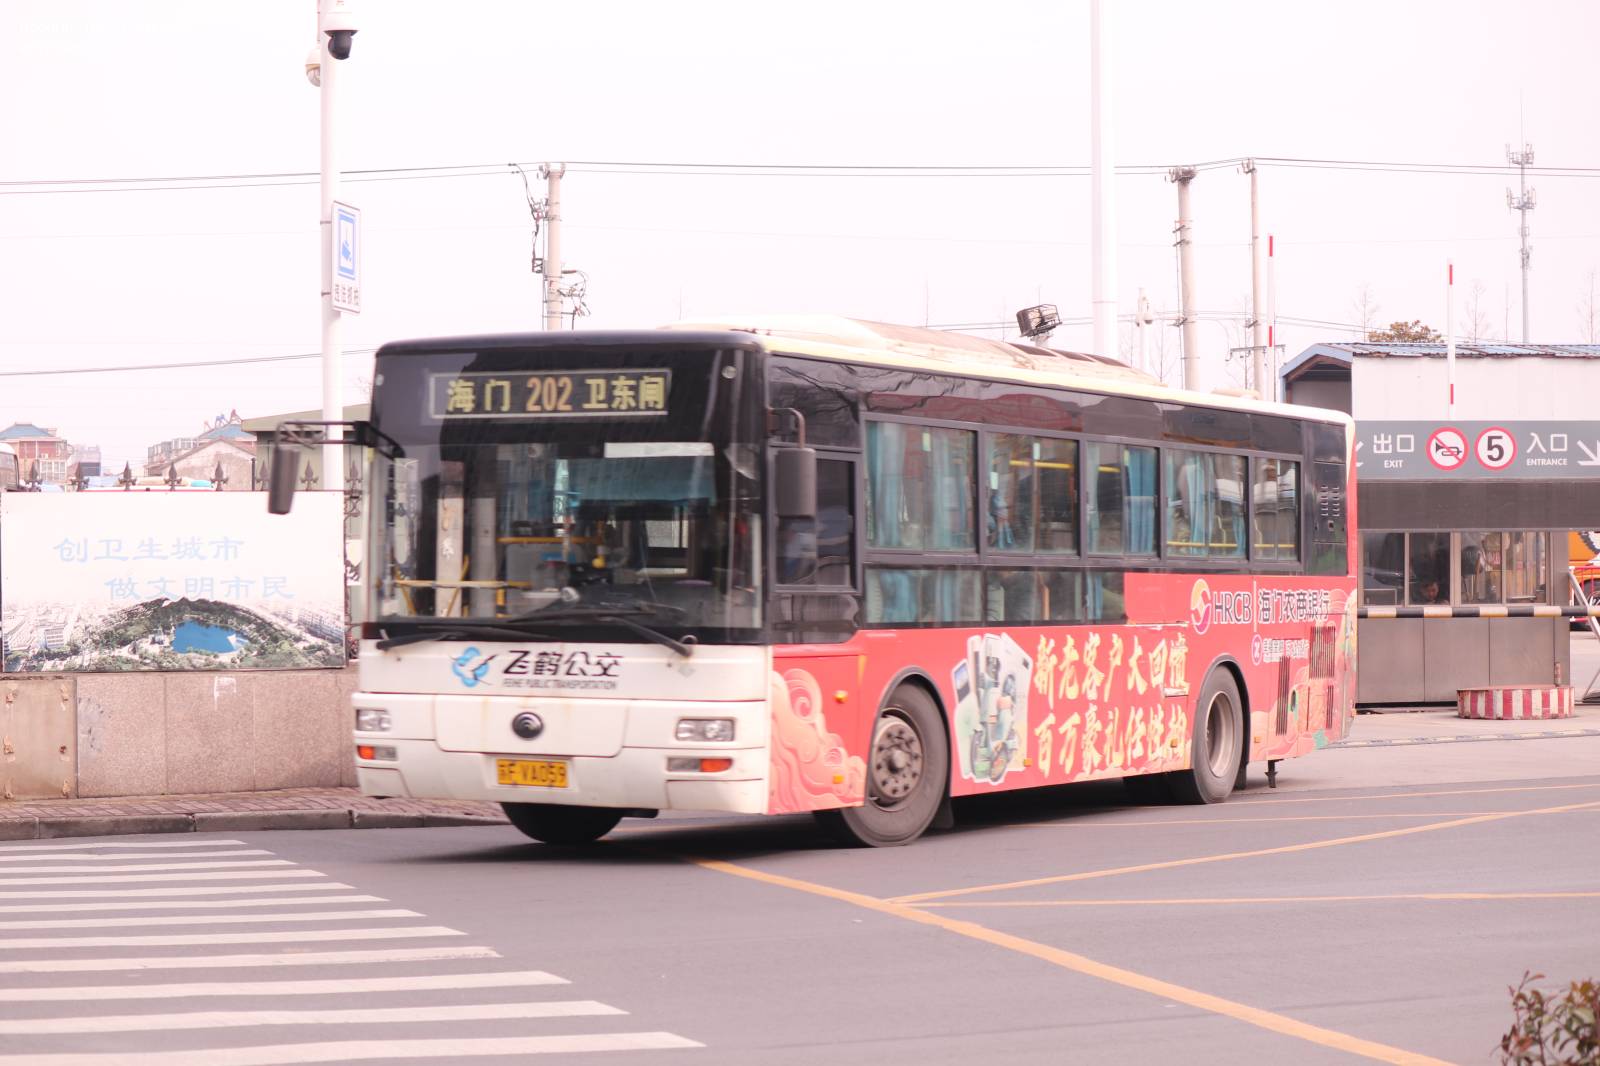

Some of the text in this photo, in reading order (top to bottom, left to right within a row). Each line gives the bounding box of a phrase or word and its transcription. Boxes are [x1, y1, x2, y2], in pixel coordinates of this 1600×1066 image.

[447, 379, 511, 412] 海门
[525, 376, 573, 412] 202
[1373, 433, 1414, 454] 出口
[1487, 436, 1504, 462] 5
[1526, 432, 1568, 453] 入口
[1384, 460, 1404, 468] EXIT
[1526, 458, 1568, 466] ENTRANCE
[54, 536, 244, 563] 创卫生城市
[104, 575, 295, 600] 做文明市民
[1213, 591, 1252, 624] HRCB
[1258, 588, 1330, 624] 海门农商银行
[502, 650, 624, 677] 飞鹤公交
